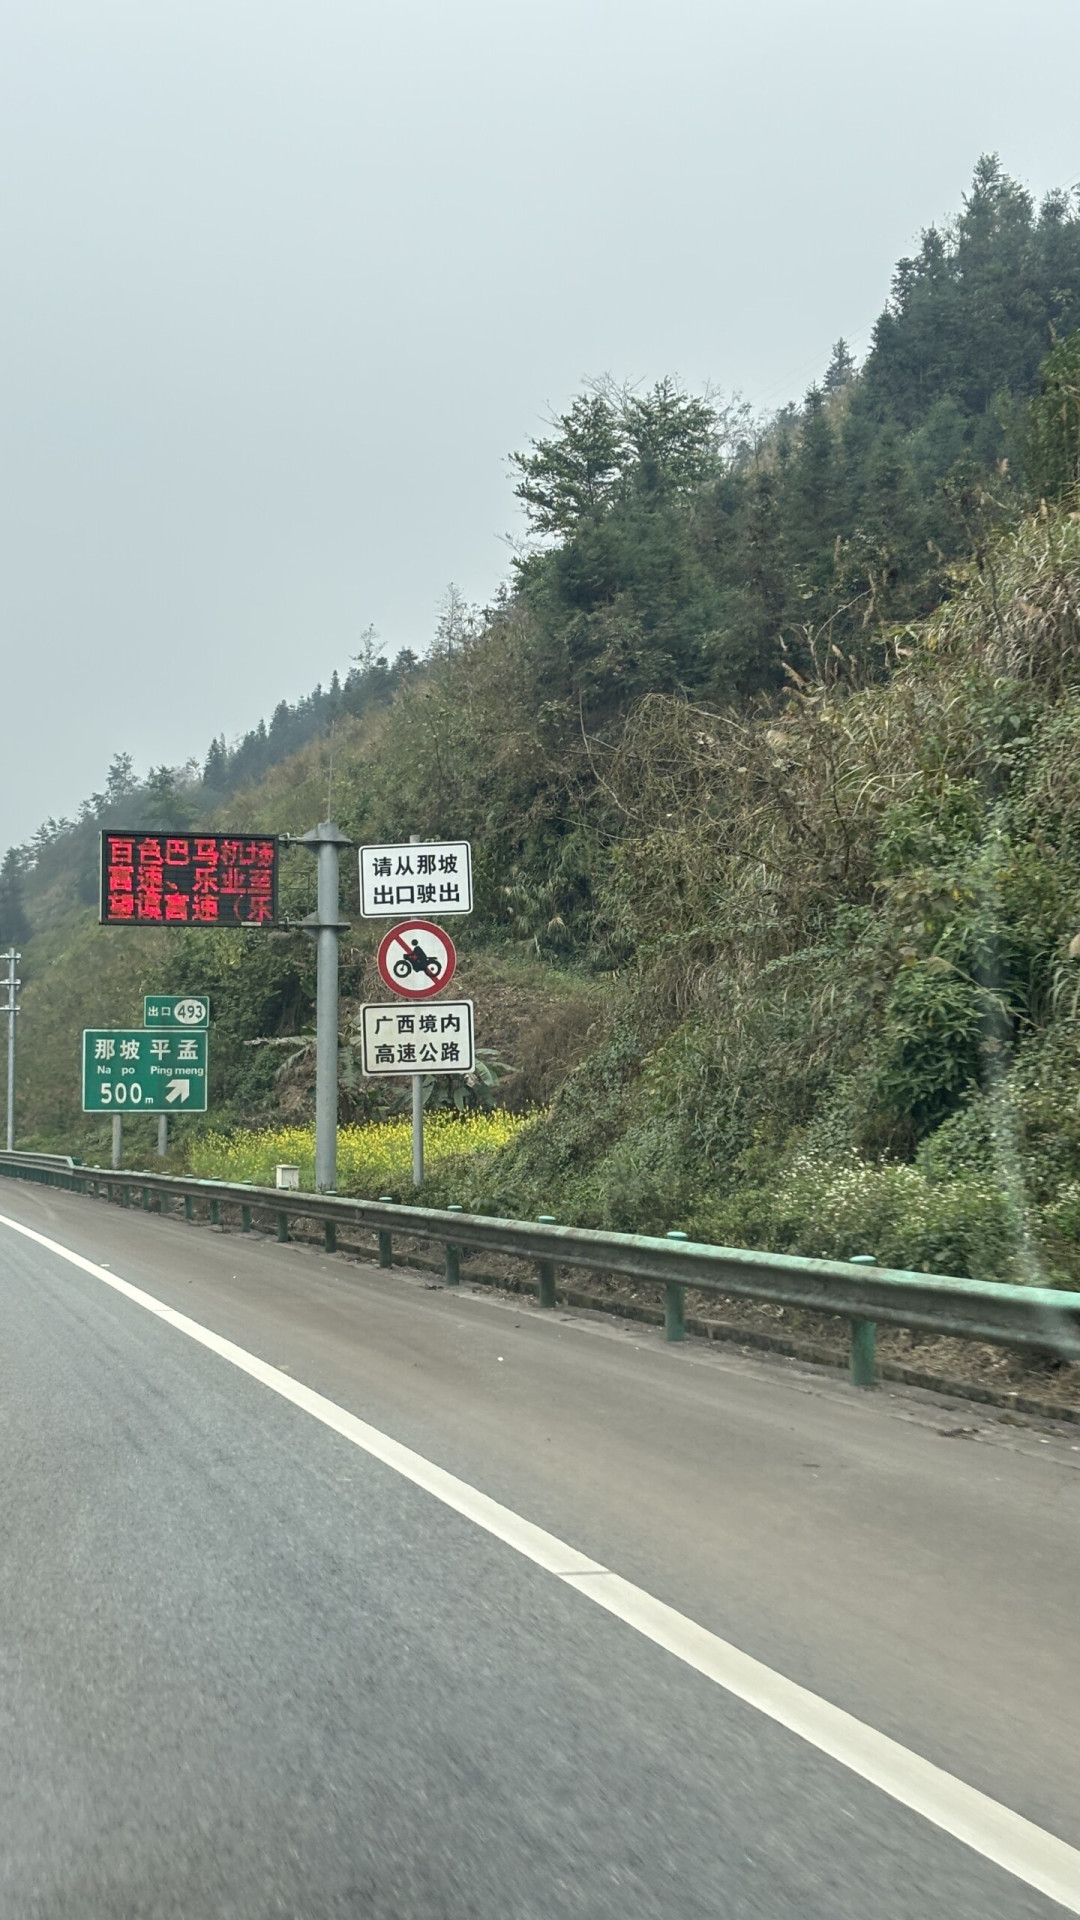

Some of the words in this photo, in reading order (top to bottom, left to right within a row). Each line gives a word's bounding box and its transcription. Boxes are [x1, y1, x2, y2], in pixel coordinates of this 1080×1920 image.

[108, 837, 274, 867] 百色巴马机场
[372, 854, 458, 877] 请从那坡
[373, 882, 460, 905] 出口驶出
[148, 1006, 171, 1017] 出口
[177, 1005, 203, 1019] 493
[374, 1013, 460, 1035] 广西境内
[374, 1041, 460, 1064] 高速公路
[97, 1065, 112, 1074] Na
[121, 1066, 136, 1076] po
